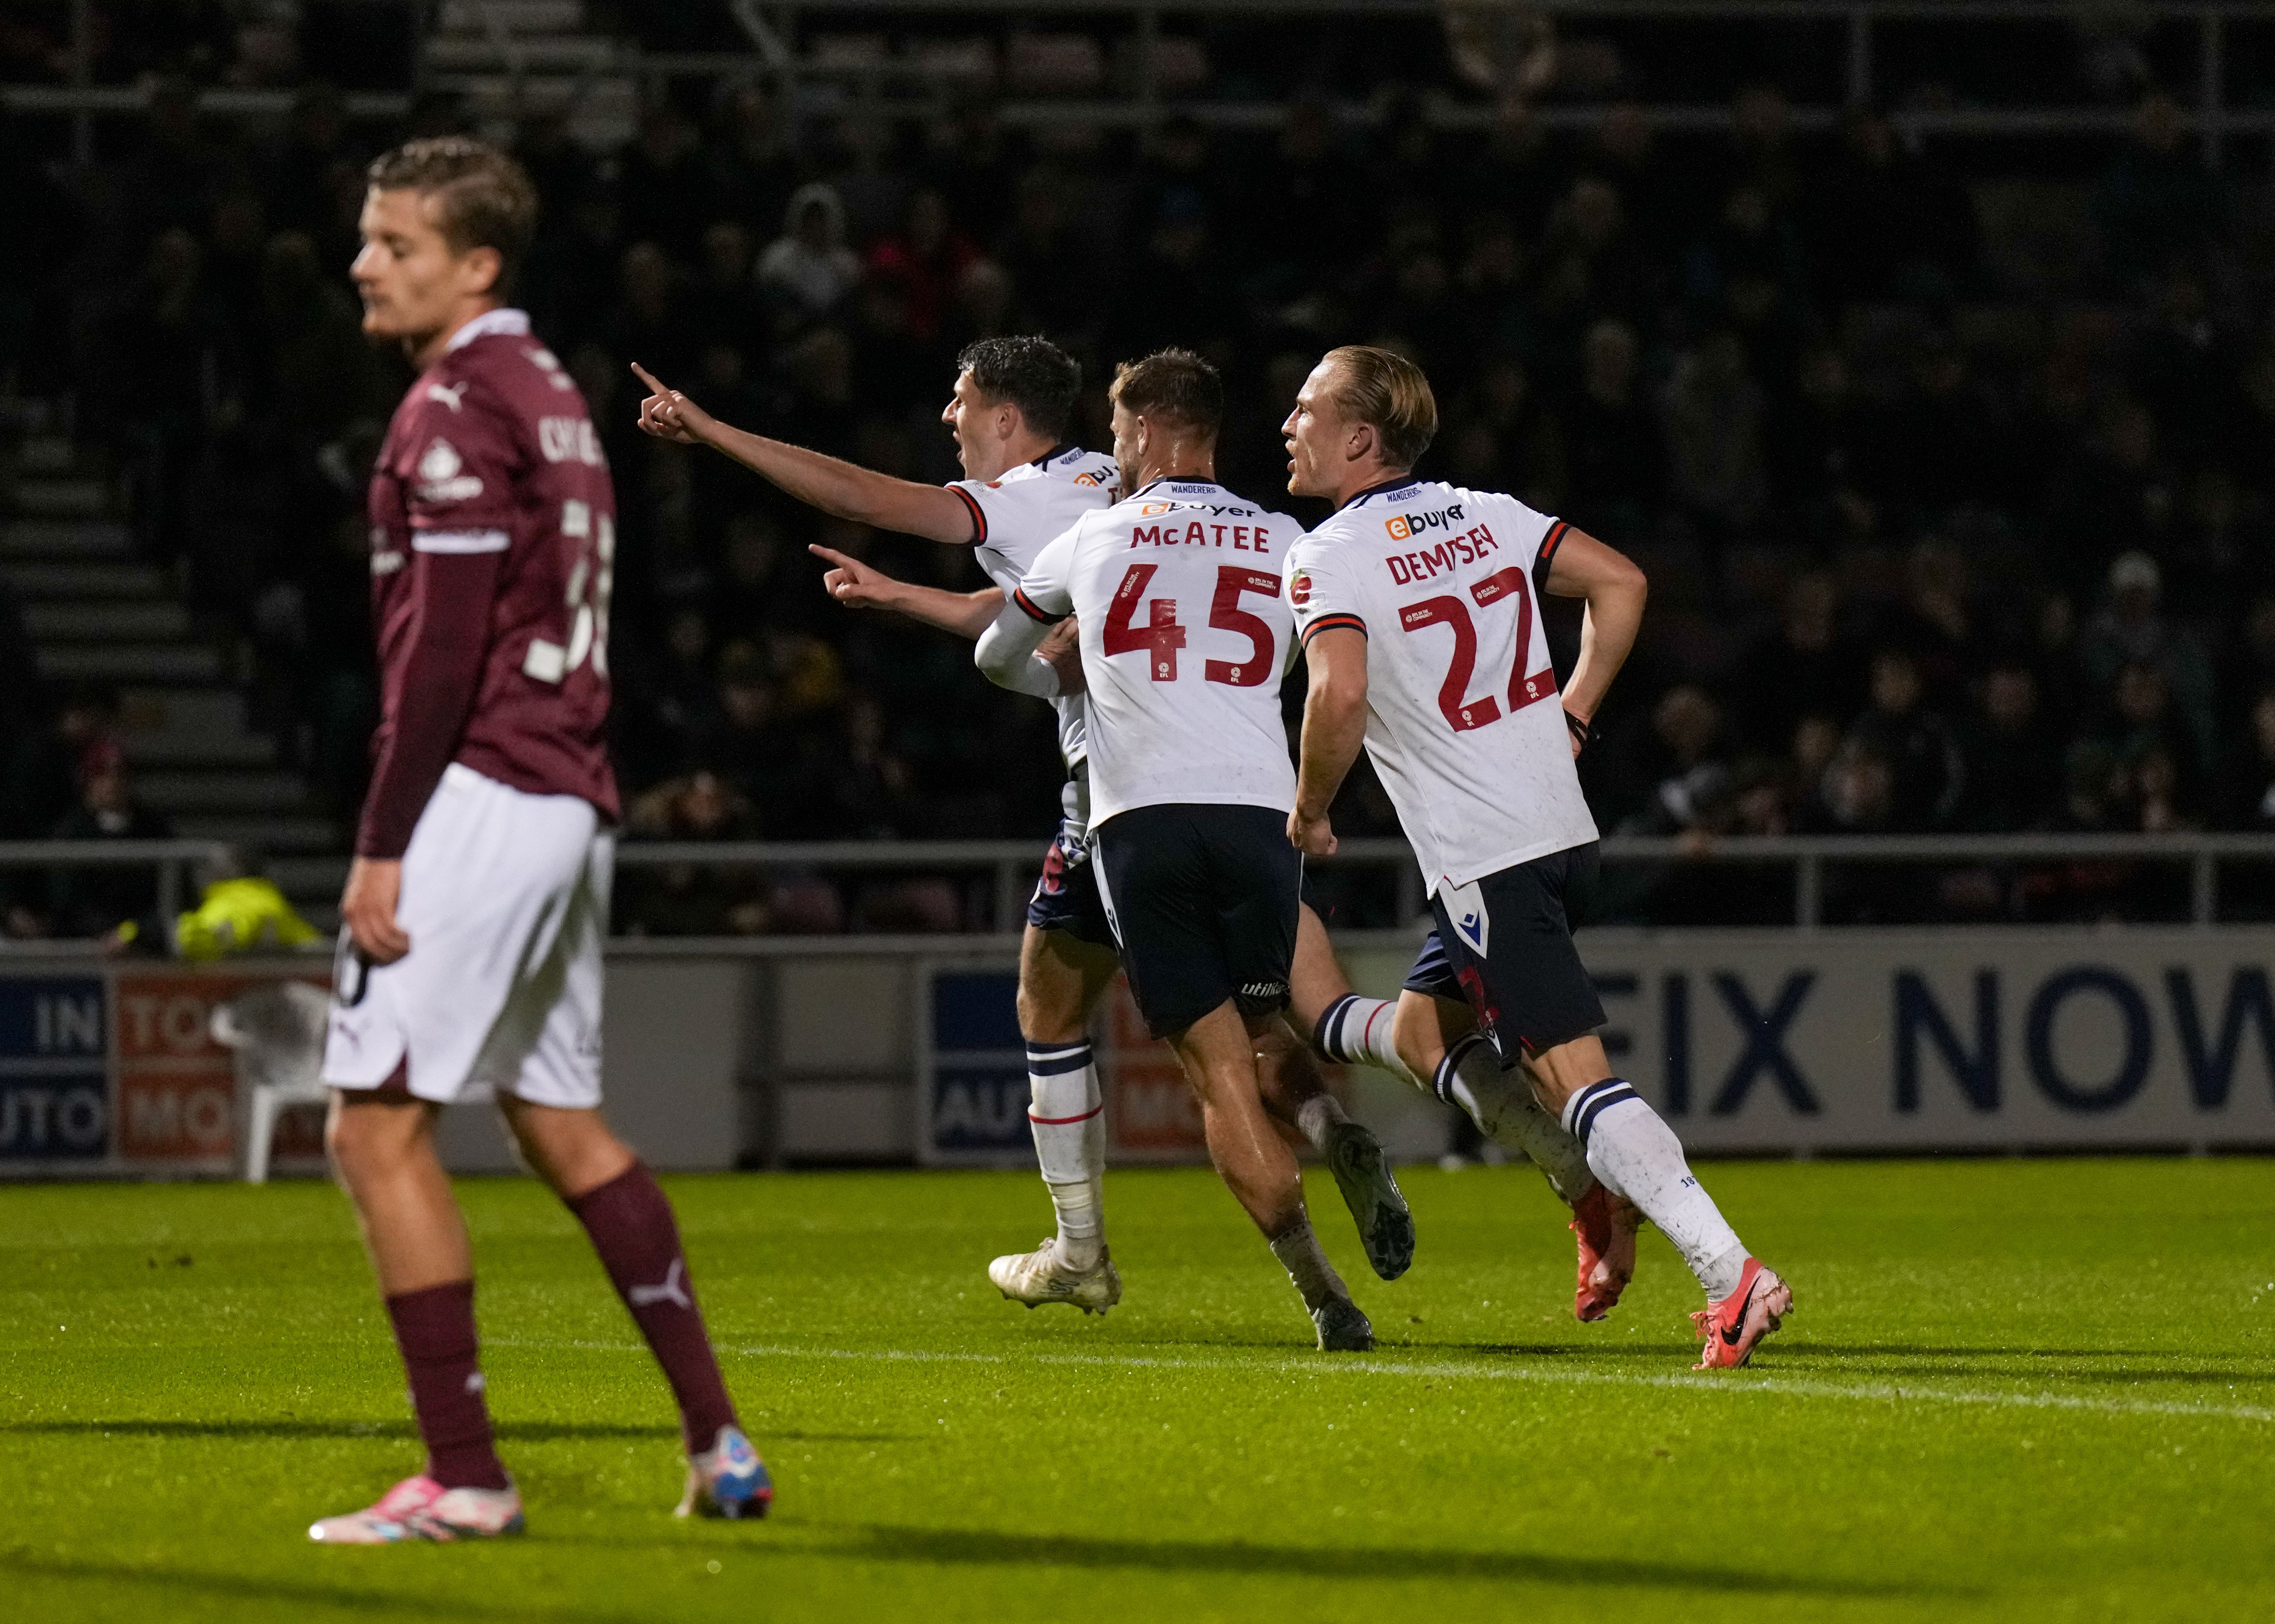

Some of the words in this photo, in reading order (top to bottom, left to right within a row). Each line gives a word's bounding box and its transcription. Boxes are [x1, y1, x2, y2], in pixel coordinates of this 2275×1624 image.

[1171, 485, 1216, 494] WANDERERS
[1386, 487, 1421, 502] WANDERERS
[1130, 522, 1269, 553] McATEE
[1385, 504, 1465, 541] ebuyer
[1385, 523, 1499, 585] DEMPSEY
[1103, 563, 1282, 687] 45
[1398, 566, 1559, 732] 22
[36, 995, 101, 1050] IN
[1893, 967, 2275, 1114] NOW
